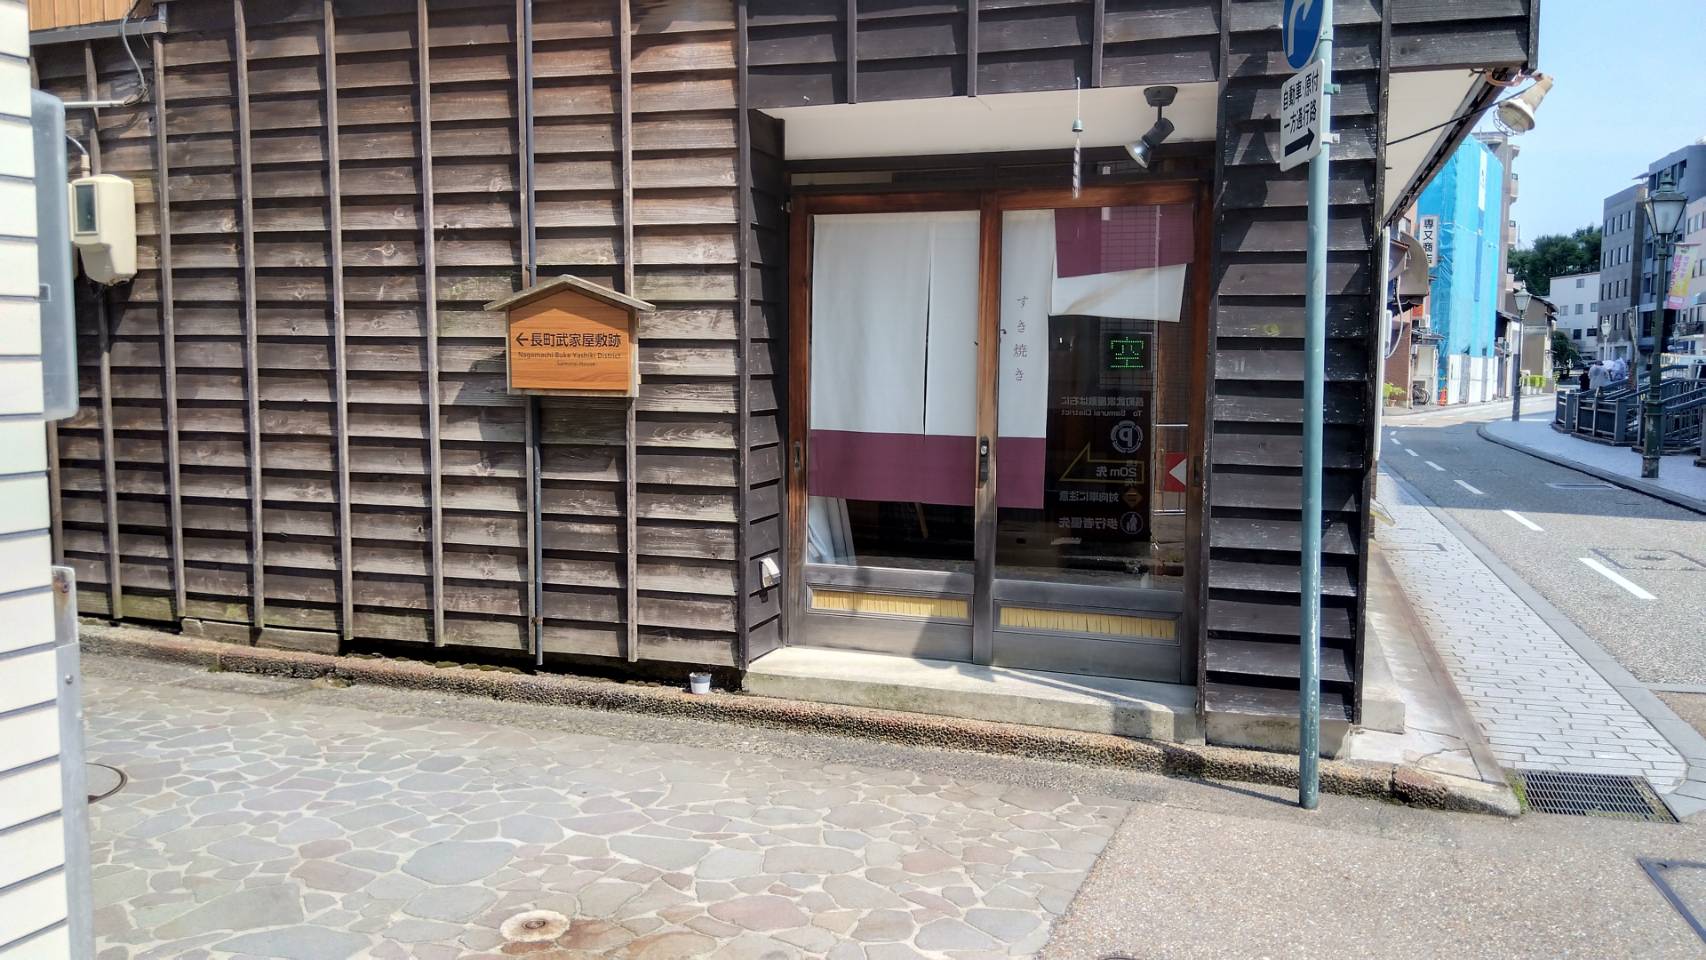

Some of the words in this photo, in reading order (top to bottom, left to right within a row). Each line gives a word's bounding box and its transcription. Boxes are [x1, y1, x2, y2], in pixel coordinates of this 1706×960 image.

[1283, 99, 1317, 135] 一方通行路
[531, 332, 622, 348] 長町武家屋敷跡
[1014, 295, 1029, 382] すき焼き
[518, 351, 553, 360] Nagamachi
